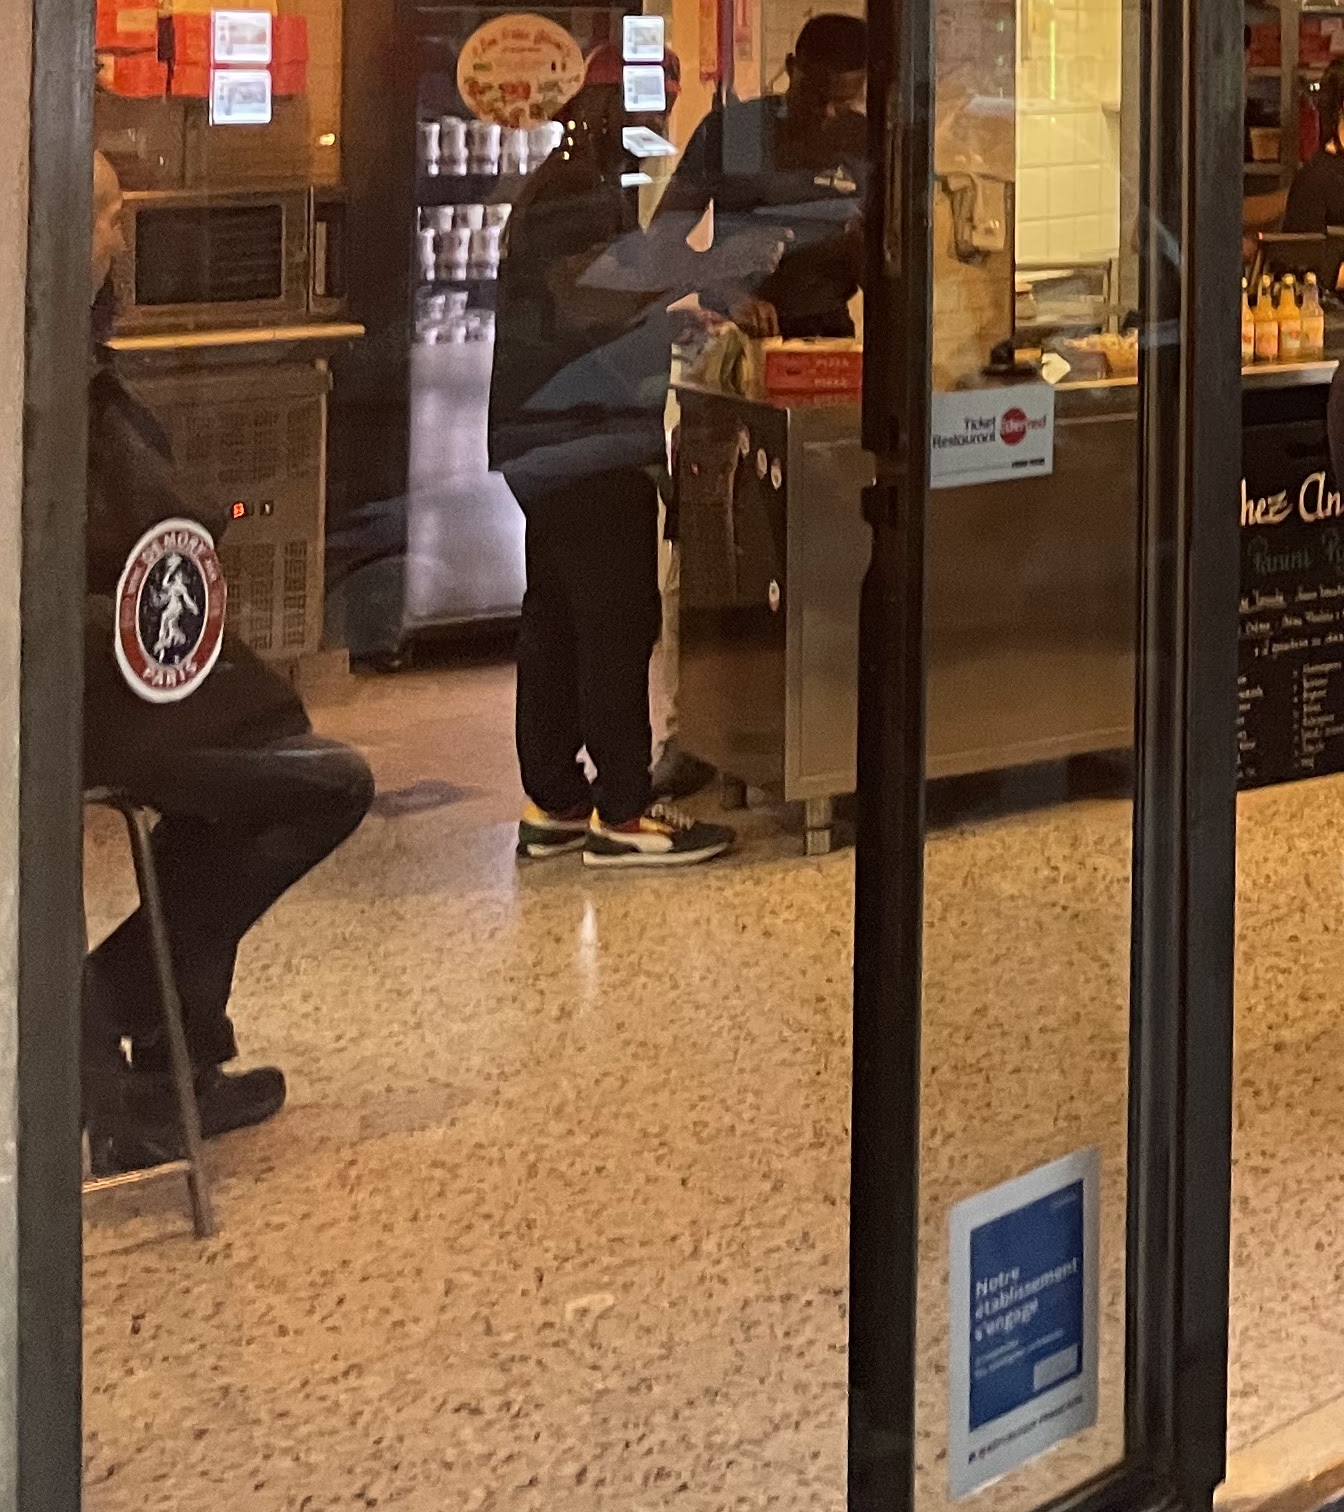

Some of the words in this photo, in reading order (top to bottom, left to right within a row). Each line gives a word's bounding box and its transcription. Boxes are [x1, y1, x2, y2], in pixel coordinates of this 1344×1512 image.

[964, 415, 996, 431] Ticket
[932, 432, 996, 450] Restaurant
[1240, 477, 1294, 527] hez
[142, 660, 199, 689] PARIS
[975, 1257, 1078, 1320] établissement
[976, 1266, 1020, 1297] Notre
